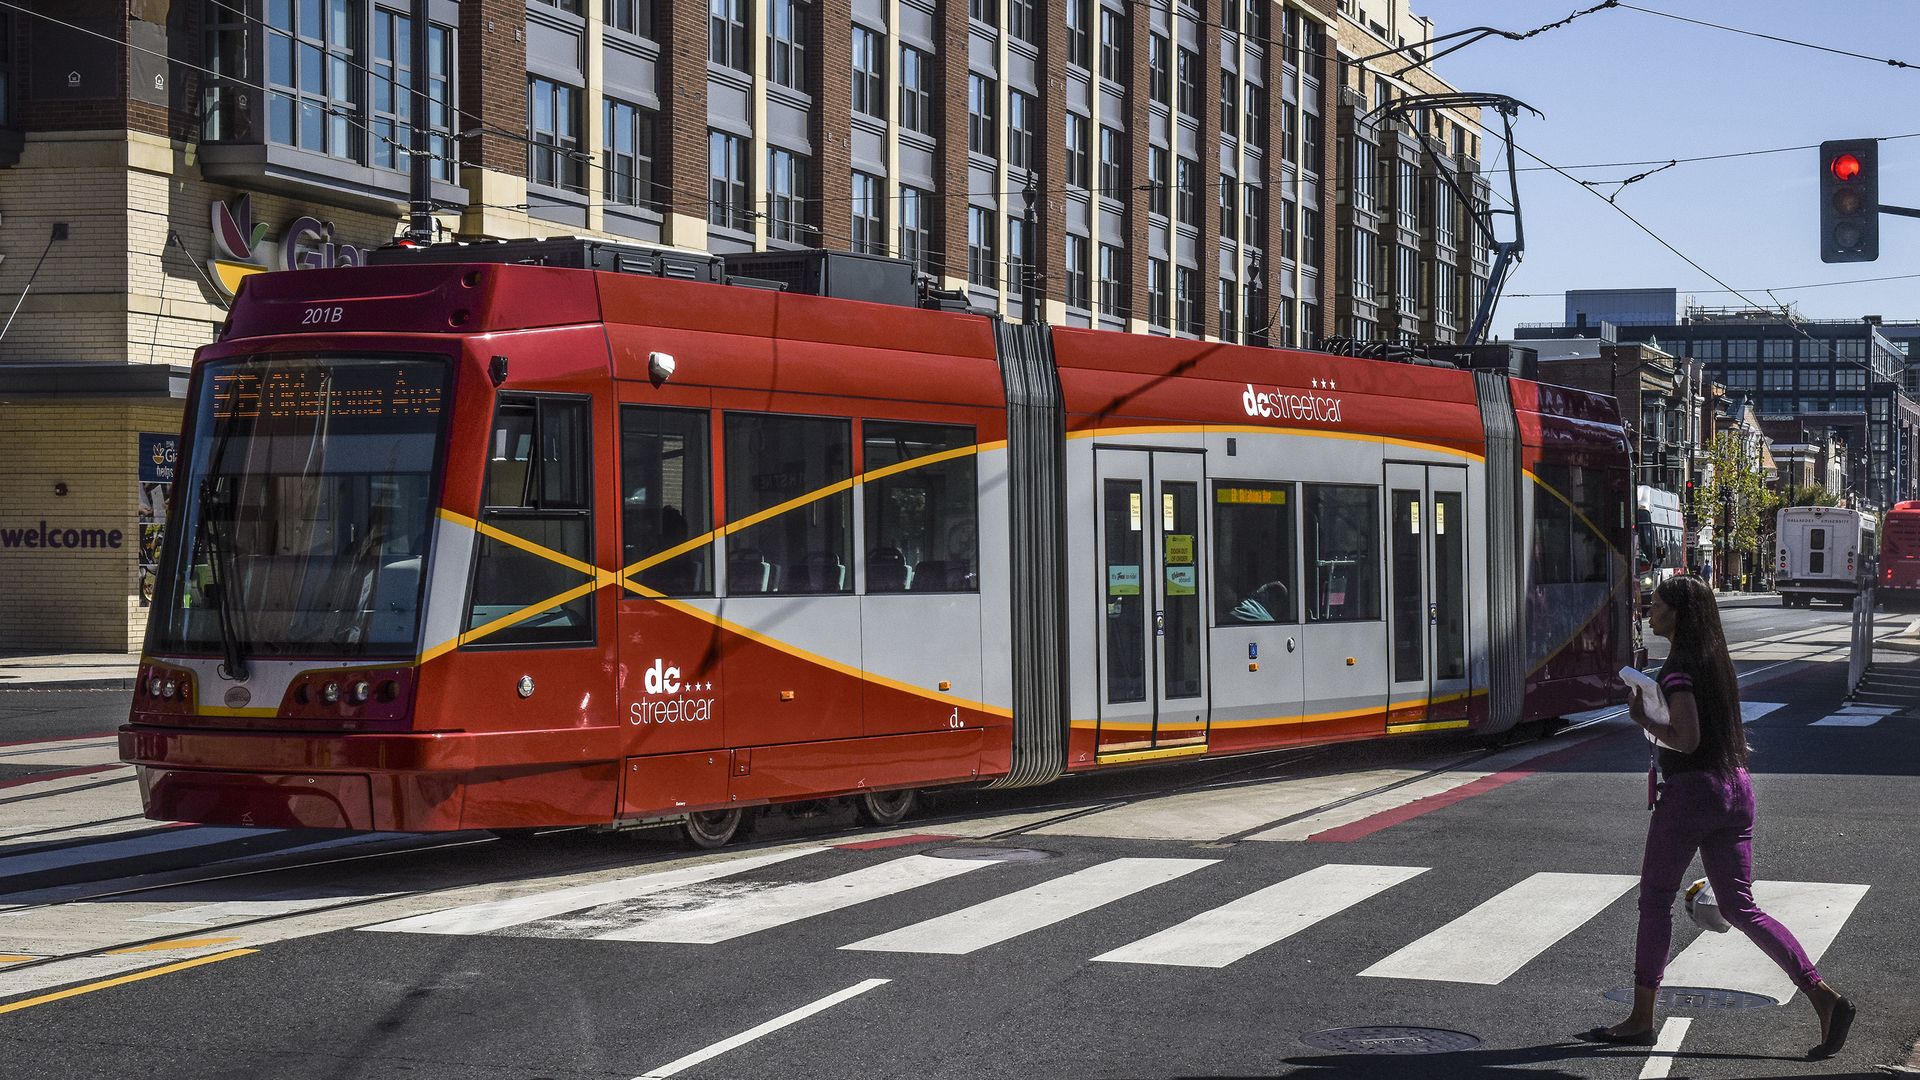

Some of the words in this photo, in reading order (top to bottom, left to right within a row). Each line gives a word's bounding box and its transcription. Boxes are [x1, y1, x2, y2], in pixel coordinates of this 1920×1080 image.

[287, 216, 369, 271] Gia
[302, 307, 343, 324] 201B
[0, 521, 123, 548] welcome
[645, 658, 680, 694] dc
[631, 695, 714, 725] streetcar
